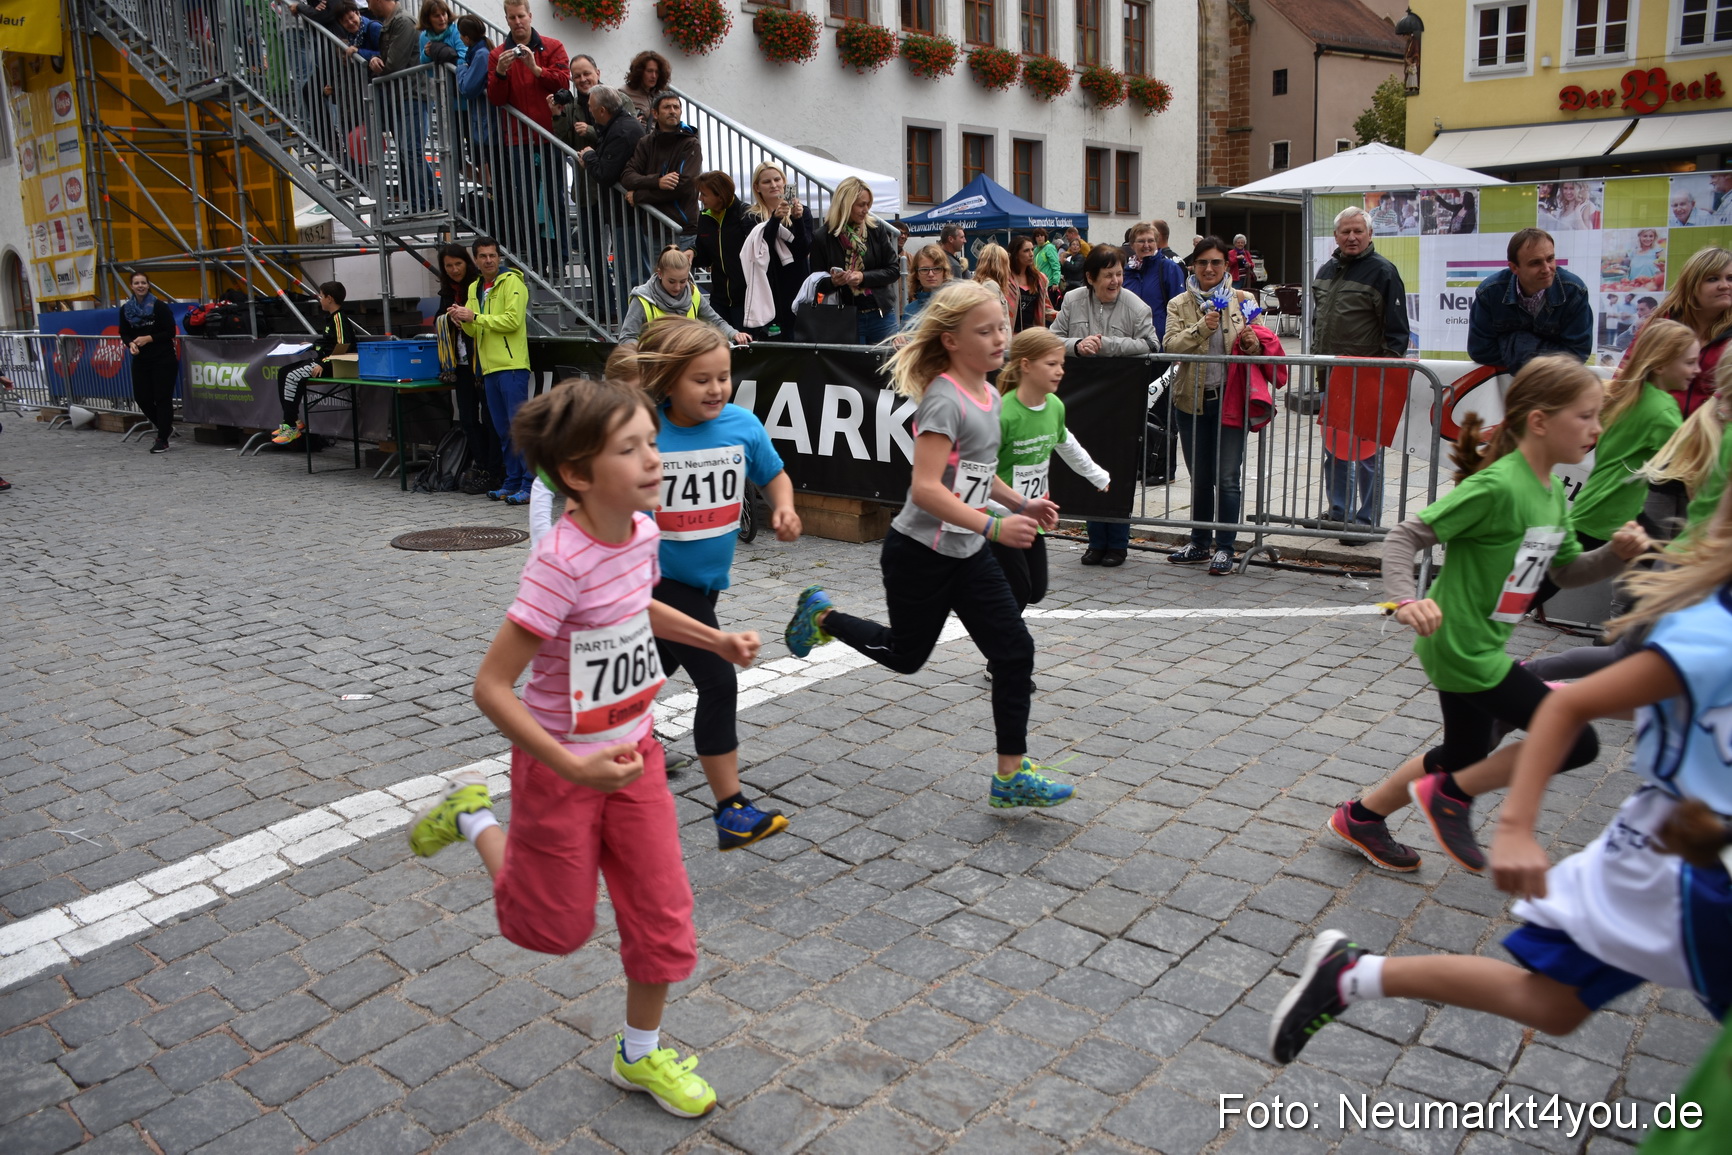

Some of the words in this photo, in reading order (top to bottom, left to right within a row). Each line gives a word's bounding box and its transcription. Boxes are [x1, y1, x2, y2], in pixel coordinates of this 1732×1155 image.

[1559, 85, 1617, 111] Der
[1620, 67, 1726, 114] Beck
[191, 363, 248, 388] BOCK
[685, 457, 730, 470] Neumarkt
[663, 469, 737, 507] 7410
[574, 640, 617, 654] PARTL
